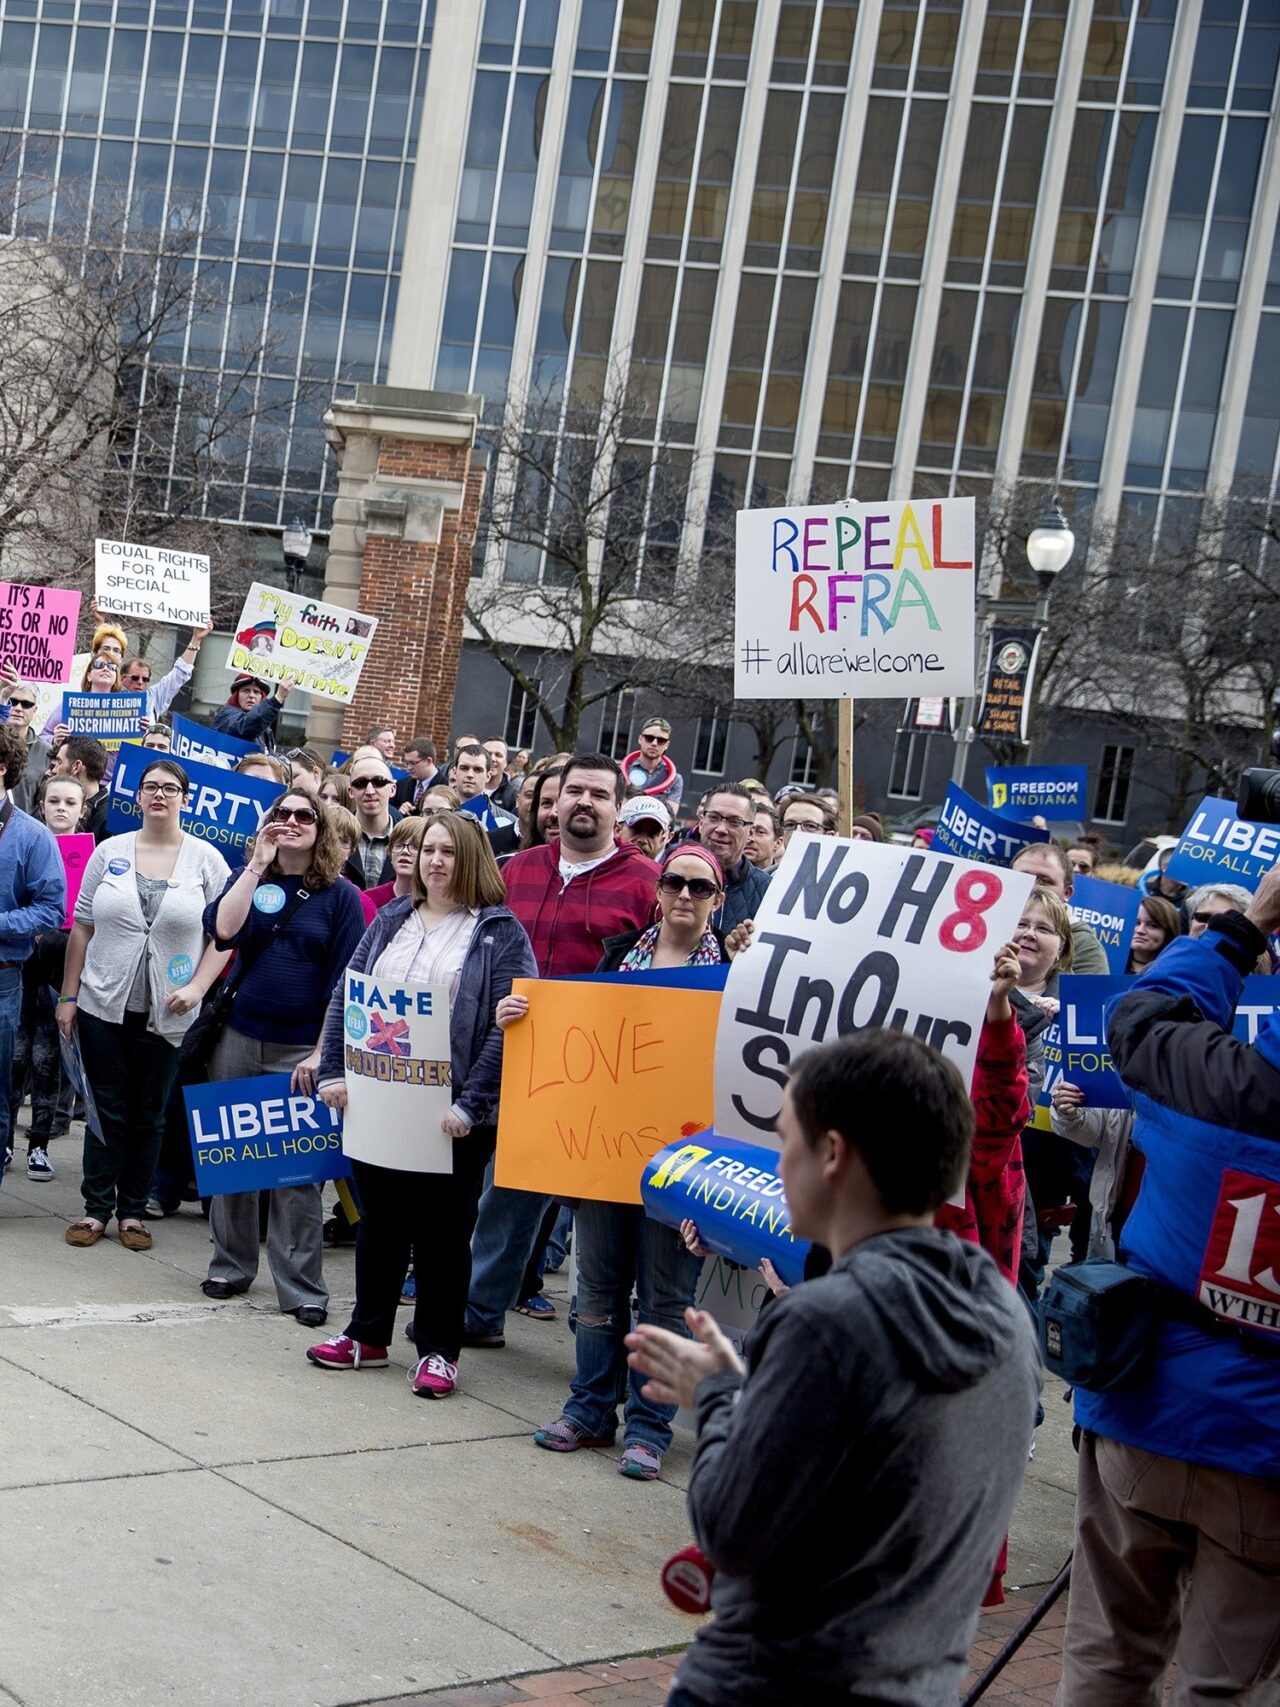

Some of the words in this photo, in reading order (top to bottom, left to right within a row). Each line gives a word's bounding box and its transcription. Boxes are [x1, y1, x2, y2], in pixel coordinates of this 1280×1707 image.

[772, 502, 973, 573] REPEAL
[101, 543, 153, 560] EQUAL
[158, 551, 209, 573] RIGHTS
[122, 560, 155, 576] FOR
[163, 568, 191, 582] ALL
[8, 585, 30, 608] IT'S
[35, 589, 45, 609] A
[106, 575, 171, 594] SPECIAL
[98, 595, 153, 615] RIGHTS
[157, 601, 165, 613] 4
[168, 607, 209, 624] NONE
[300, 604, 340, 634] faith
[789, 568, 943, 637] RFRA
[21, 611, 41, 633] OR
[48, 615, 69, 635] NO
[740, 639, 945, 676] #allarewelcome
[68, 697, 100, 708] FREEDOM
[101, 698, 111, 708] OF
[112, 698, 142, 708] RELIGION
[67, 717, 141, 733] DISCRIMINATE
[170, 730, 243, 764] LIBERT
[114, 764, 273, 831] LERTY
[1011, 781, 1079, 794] FREEDOM
[1011, 794, 1077, 806] INDIANA
[112, 797, 143, 819] FOR
[180, 818, 256, 848] HOOSIER
[1187, 812, 1280, 862] LIBE
[936, 825, 950, 844] FOR
[948, 837, 969, 859] ALL
[1179, 841, 1216, 863] FOR
[1217, 854, 1252, 875] ALL
[777, 842, 869, 925] No
[877, 854, 1003, 953] H8
[1070, 906, 1125, 932] EEDOM
[346, 1044, 453, 1087] HOOSIER
[528, 1017, 664, 1099] LOVE
[1068, 1053, 1116, 1072] FOR
[192, 1094, 339, 1143] LIBERT
[555, 1105, 668, 1161] Wins
[198, 1146, 237, 1166] FOR
[241, 1142, 278, 1161] ALL
[282, 1132, 344, 1156] HOOS
[704, 1155, 787, 1203] FREED
[686, 1173, 795, 1243] INDIANA
[1206, 1286, 1280, 1329] WTH
